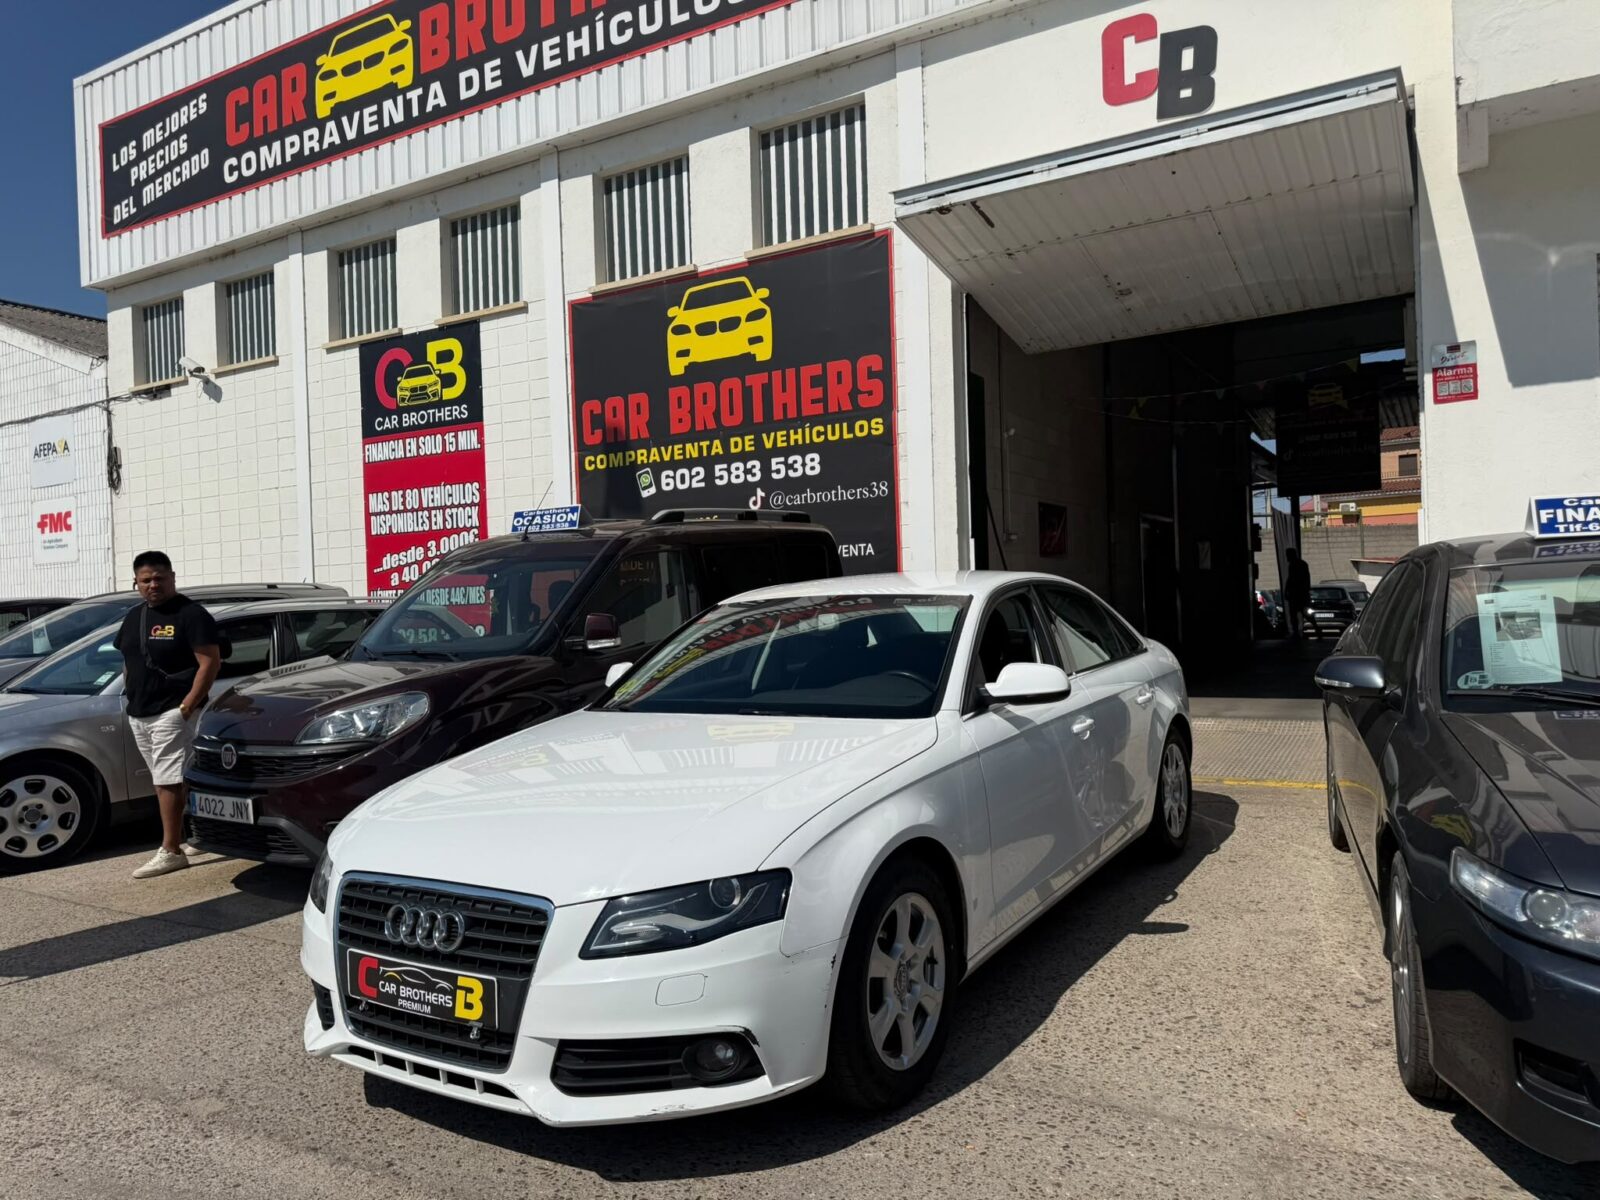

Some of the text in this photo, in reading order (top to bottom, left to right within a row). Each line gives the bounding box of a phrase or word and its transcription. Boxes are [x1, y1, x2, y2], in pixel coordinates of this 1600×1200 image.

[223, 80, 447, 184] COMPRAVENTA
[458, 57, 503, 101] DE
[225, 61, 308, 148] CAR
[112, 92, 207, 172] LOS MEJORES
[130, 133, 188, 187] PRECIOS
[113, 147, 210, 225] DEL MERCADO
[1436, 366, 1473, 378] Alarma
[581, 354, 885, 446] CAR BROTHERS
[374, 403, 469, 431] CAR BROTHERS
[364, 428, 481, 463] FINANCIA EN SOLO 15 MIN.
[583, 416, 885, 472] COMPRAVENTA DE VEHÍCULOS
[660, 453, 822, 493] 602 583 538
[368, 481, 480, 514] MAS DE 80 VEHÍCULOS
[769, 480, 889, 510] @carbrothers38
[37, 510, 73, 535] FMC
[370, 505, 480, 536] DISPONIBLES EN STOCK
[513, 511, 578, 527] OCASION
[390, 571, 400, 587] a
[198, 796, 251, 820] 4022 JNY
[378, 980, 453, 1008] CAR BROTHERS
[397, 998, 431, 1014] PREMIUM
